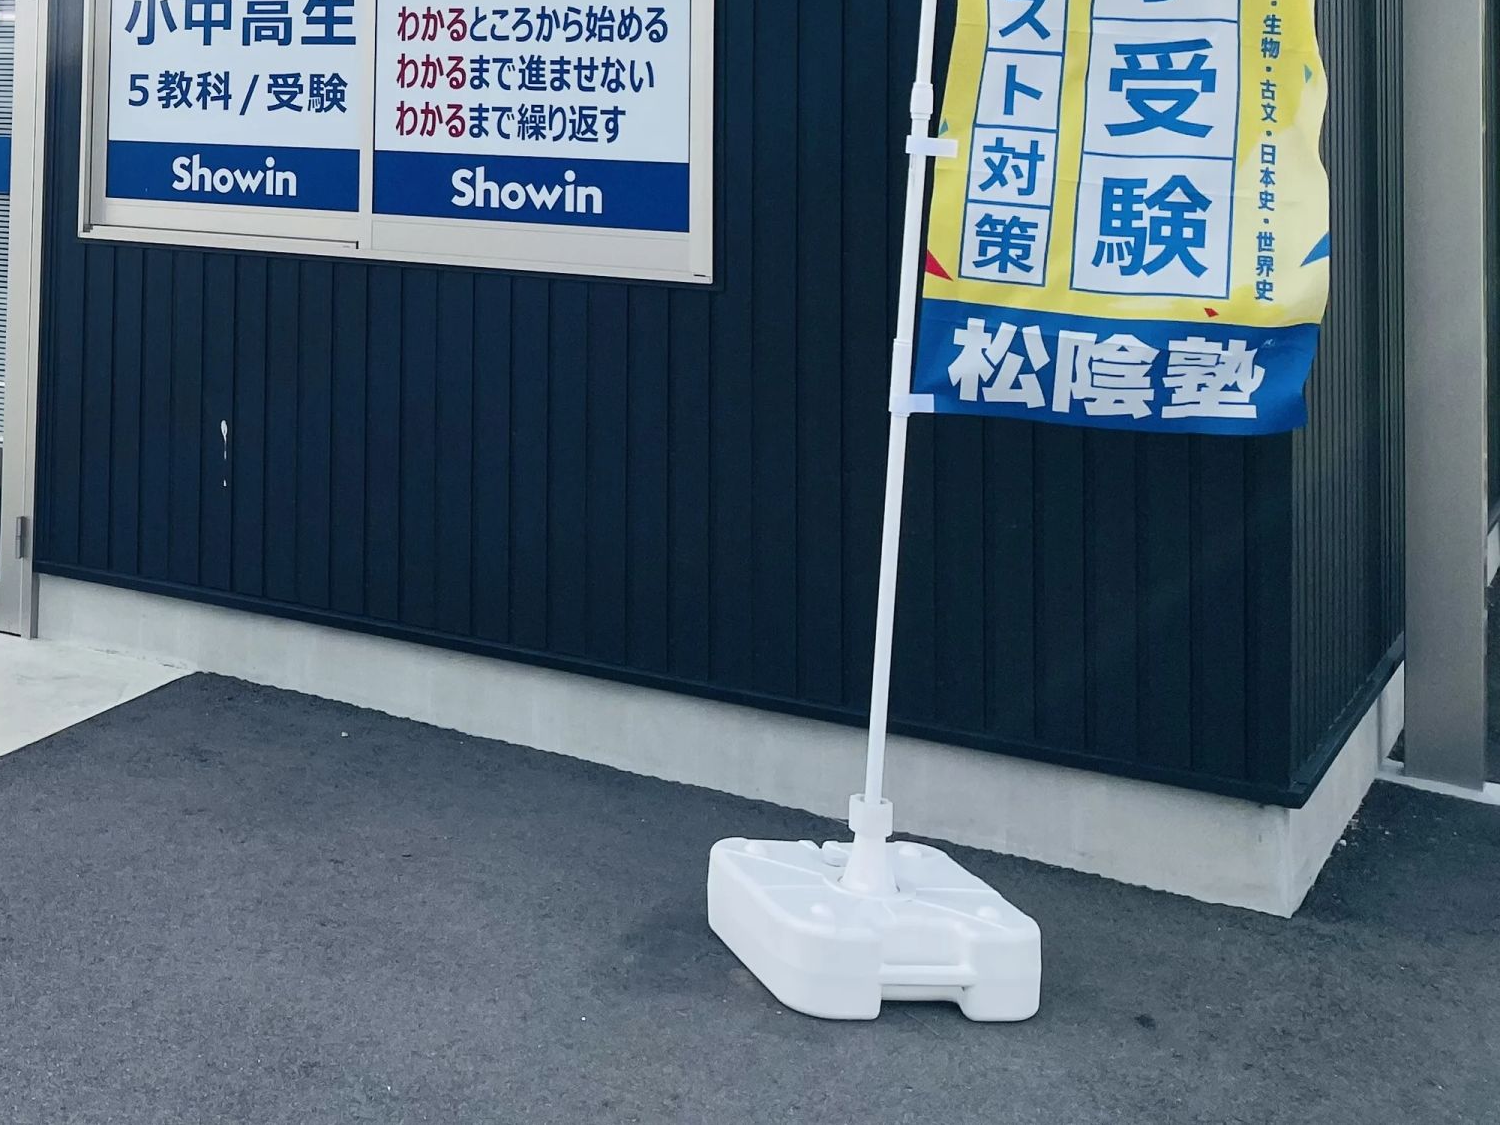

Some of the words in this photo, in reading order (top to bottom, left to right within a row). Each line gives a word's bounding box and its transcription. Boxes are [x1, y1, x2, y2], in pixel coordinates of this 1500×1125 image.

[398, 5, 668, 44] わかるところから始める
[397, 53, 655, 93] わかるまで進ませない
[396, 102, 626, 143] わかるまで繰り返す
[172, 156, 297, 198] Showin
[451, 166, 603, 215] Showin
[947, 317, 1266, 419] 松陰塾
